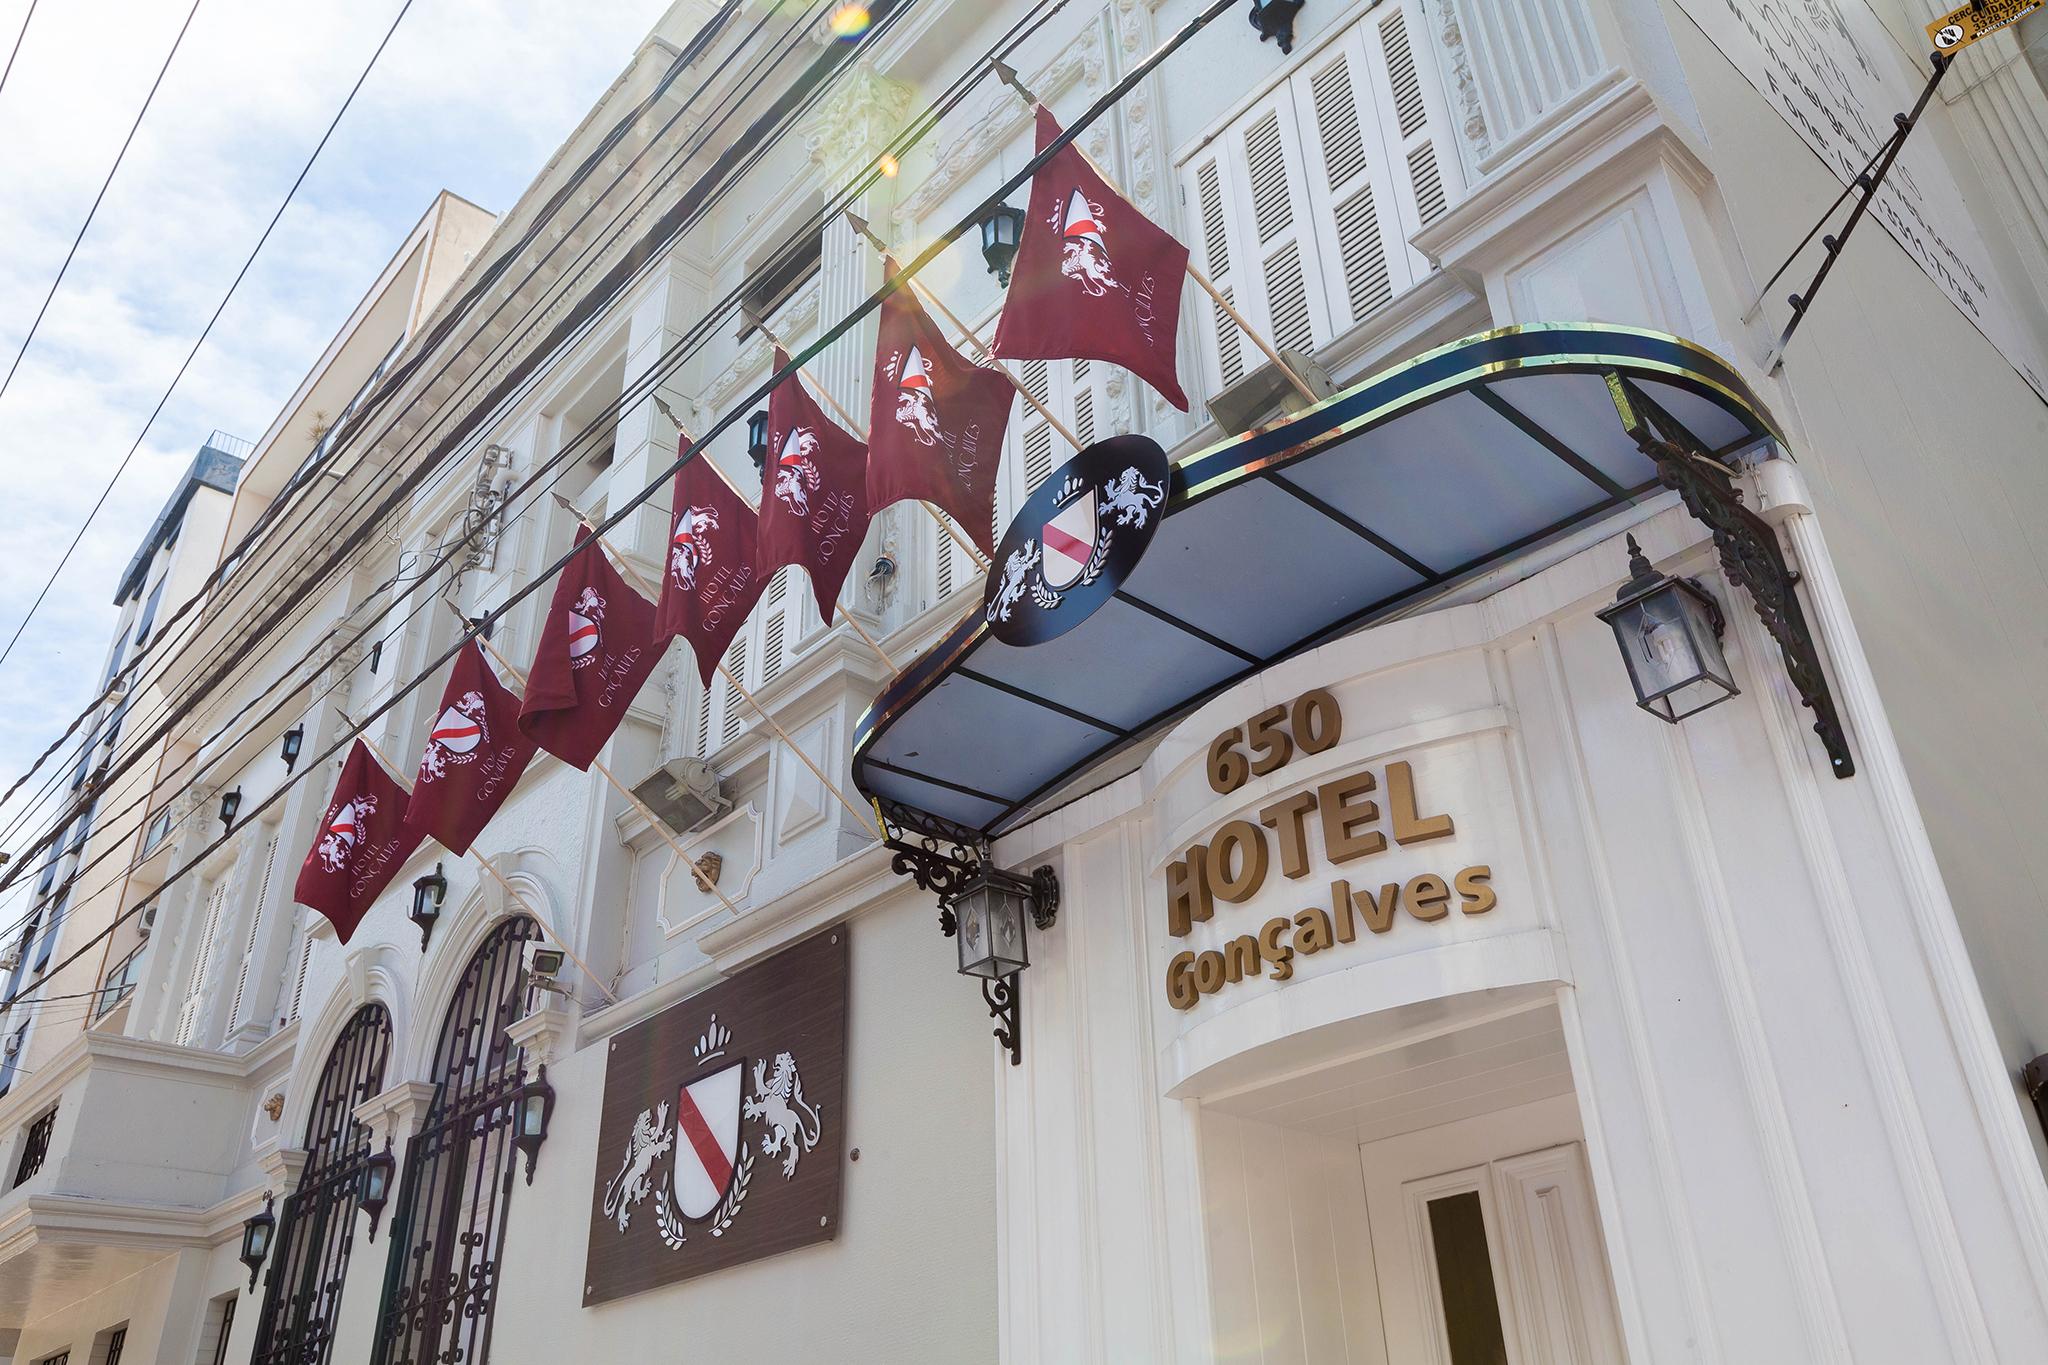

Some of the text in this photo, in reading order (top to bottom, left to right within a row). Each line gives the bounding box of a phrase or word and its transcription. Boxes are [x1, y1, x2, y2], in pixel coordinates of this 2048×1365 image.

[1948, 7, 1975, 25] CERC
[1973, 0, 2033, 31] 3328.7272
[1977, 5, 2035, 37] PLANETA ALARMES
[1764, 67, 1980, 318] Fone: (5) 3311.7736
[957, 418, 981, 494] ONÇALVES
[699, 566, 733, 604] HOTEL
[702, 562, 752, 632] GONÇALVES
[598, 652, 617, 681] HTEL
[1206, 688, 1342, 795] 650
[477, 745, 516, 801] GONLVES
[350, 838, 401, 898] GONÇALVES
[351, 843, 381, 876] HOTEL
[1166, 760, 1454, 938] HOTEL
[1166, 864, 1497, 1010] Gonçalves
